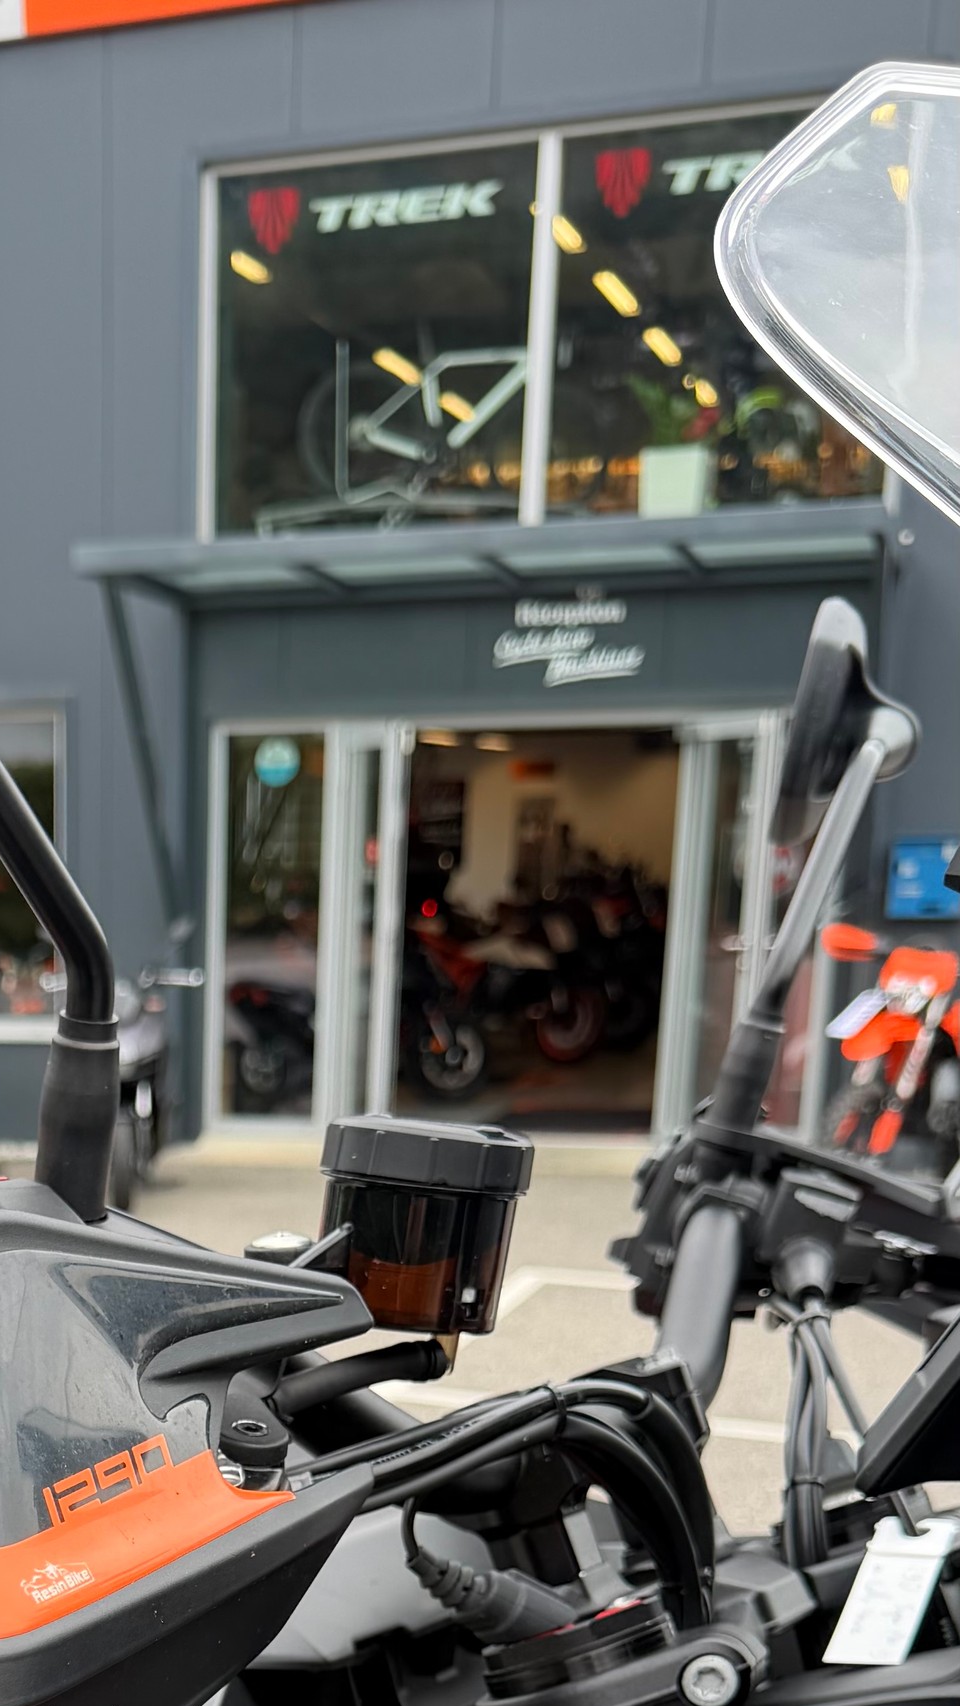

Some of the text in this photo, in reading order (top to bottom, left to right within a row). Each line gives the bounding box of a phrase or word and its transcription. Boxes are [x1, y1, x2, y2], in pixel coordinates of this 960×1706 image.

[309, 179, 503, 233] TREK
[43, 1432, 175, 1527] 1290
[31, 1569, 91, 1604] Resin Bike
